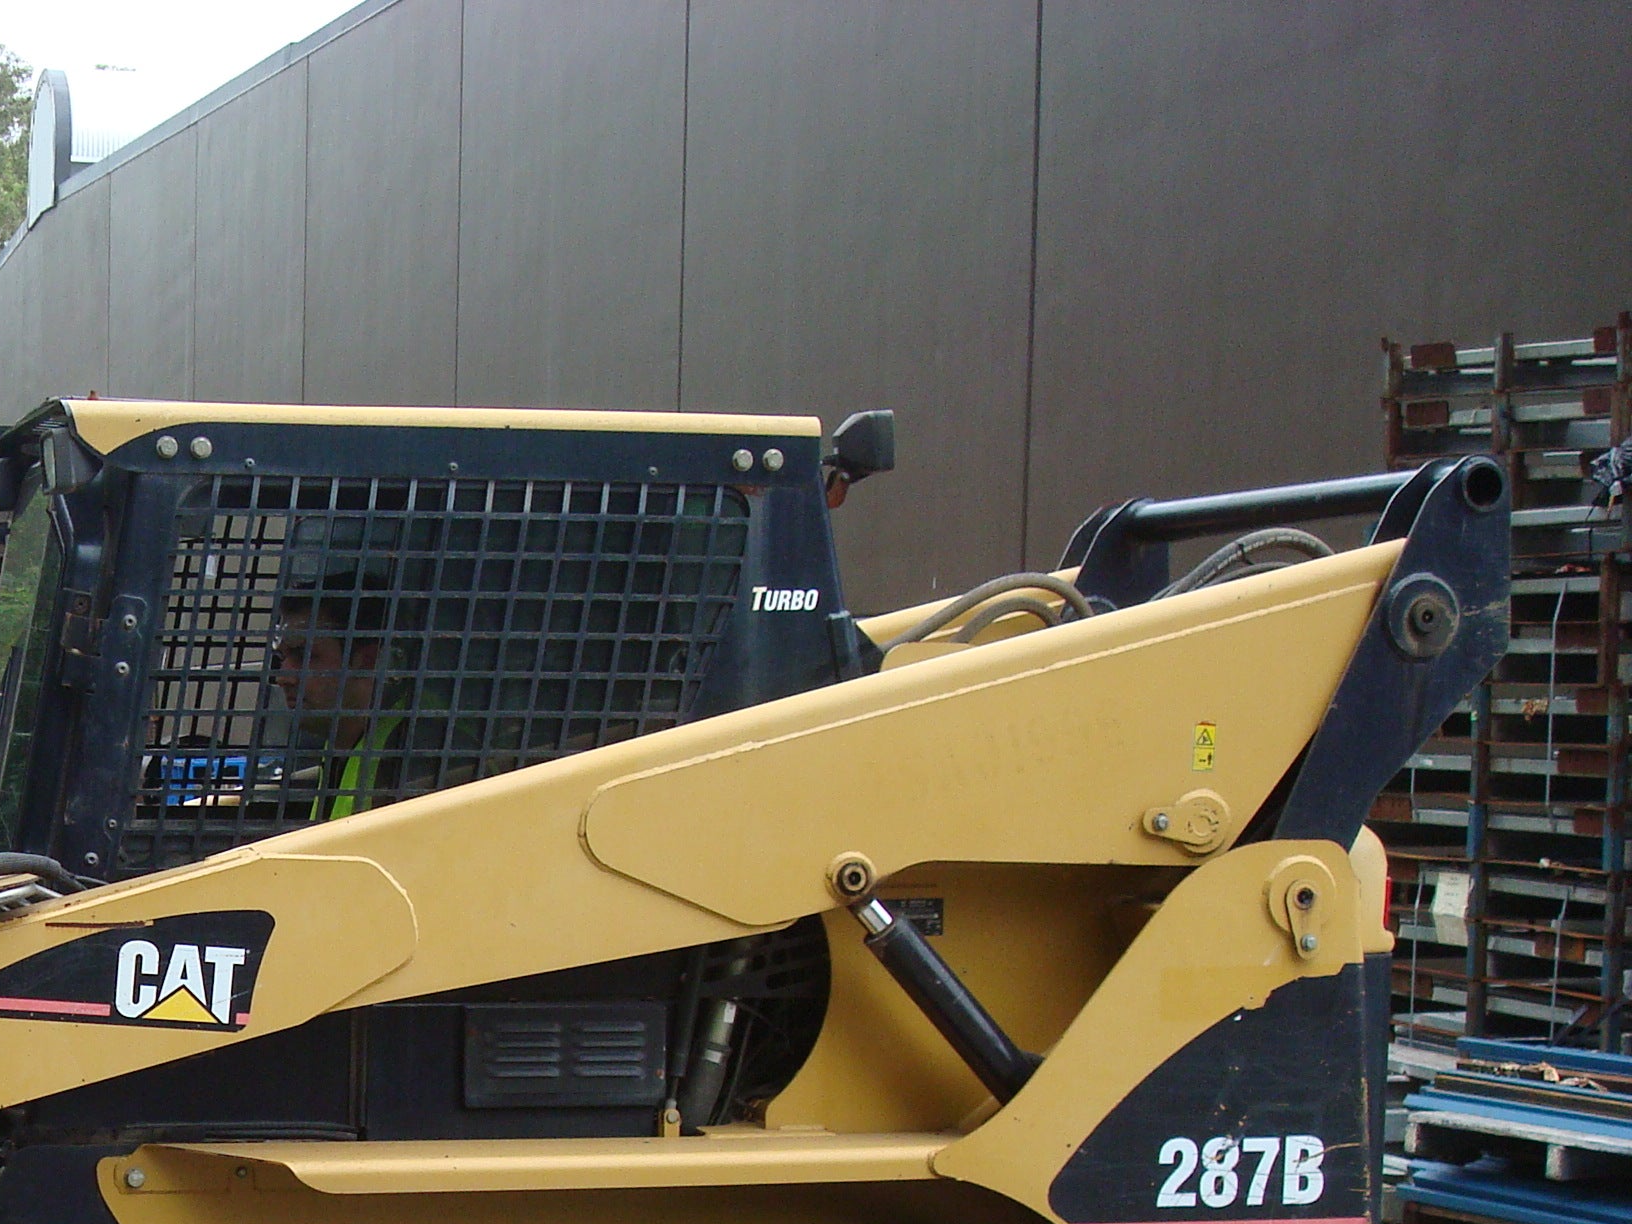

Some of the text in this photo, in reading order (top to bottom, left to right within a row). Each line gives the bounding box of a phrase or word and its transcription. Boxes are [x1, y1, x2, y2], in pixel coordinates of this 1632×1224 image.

[752, 586, 819, 611] TURBO
[115, 940, 246, 1024] CAT
[1156, 1136, 1325, 1208] 287B
